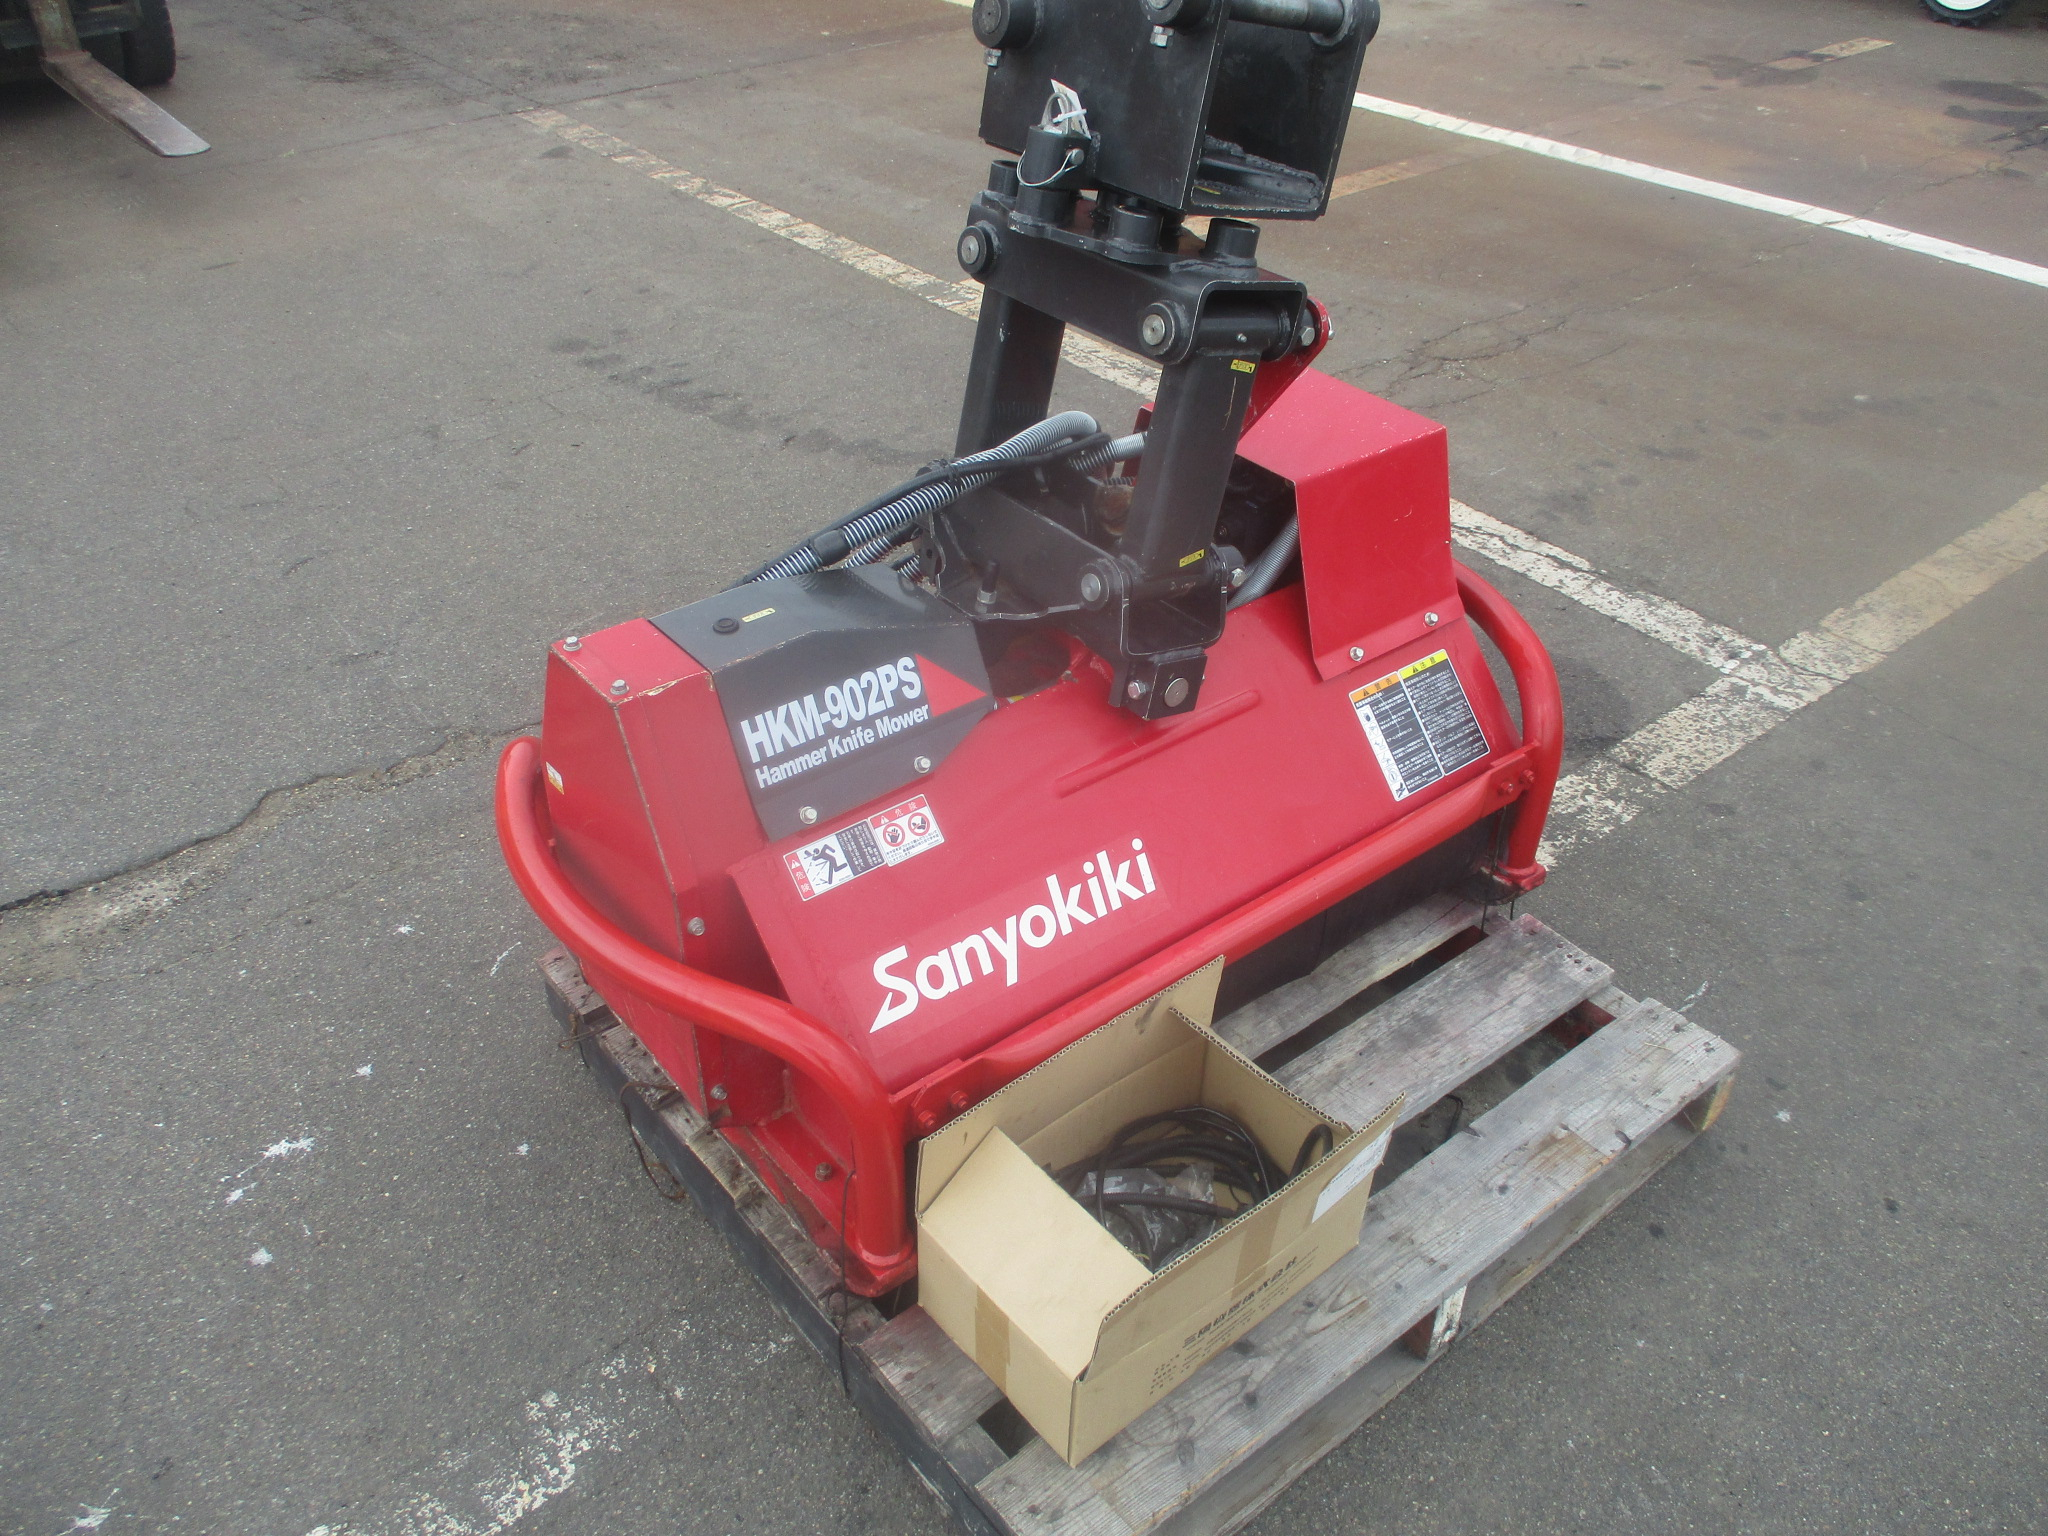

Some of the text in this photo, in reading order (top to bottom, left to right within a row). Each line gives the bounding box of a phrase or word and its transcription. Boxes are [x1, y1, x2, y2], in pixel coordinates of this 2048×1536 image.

[740, 656, 922, 763] HKM-902PS
[754, 704, 930, 788] Hammer Knife Mower
[895, 801, 918, 817] 危険
[795, 870, 812, 893] 危険
[869, 838, 1157, 1034] Sanyokiki
